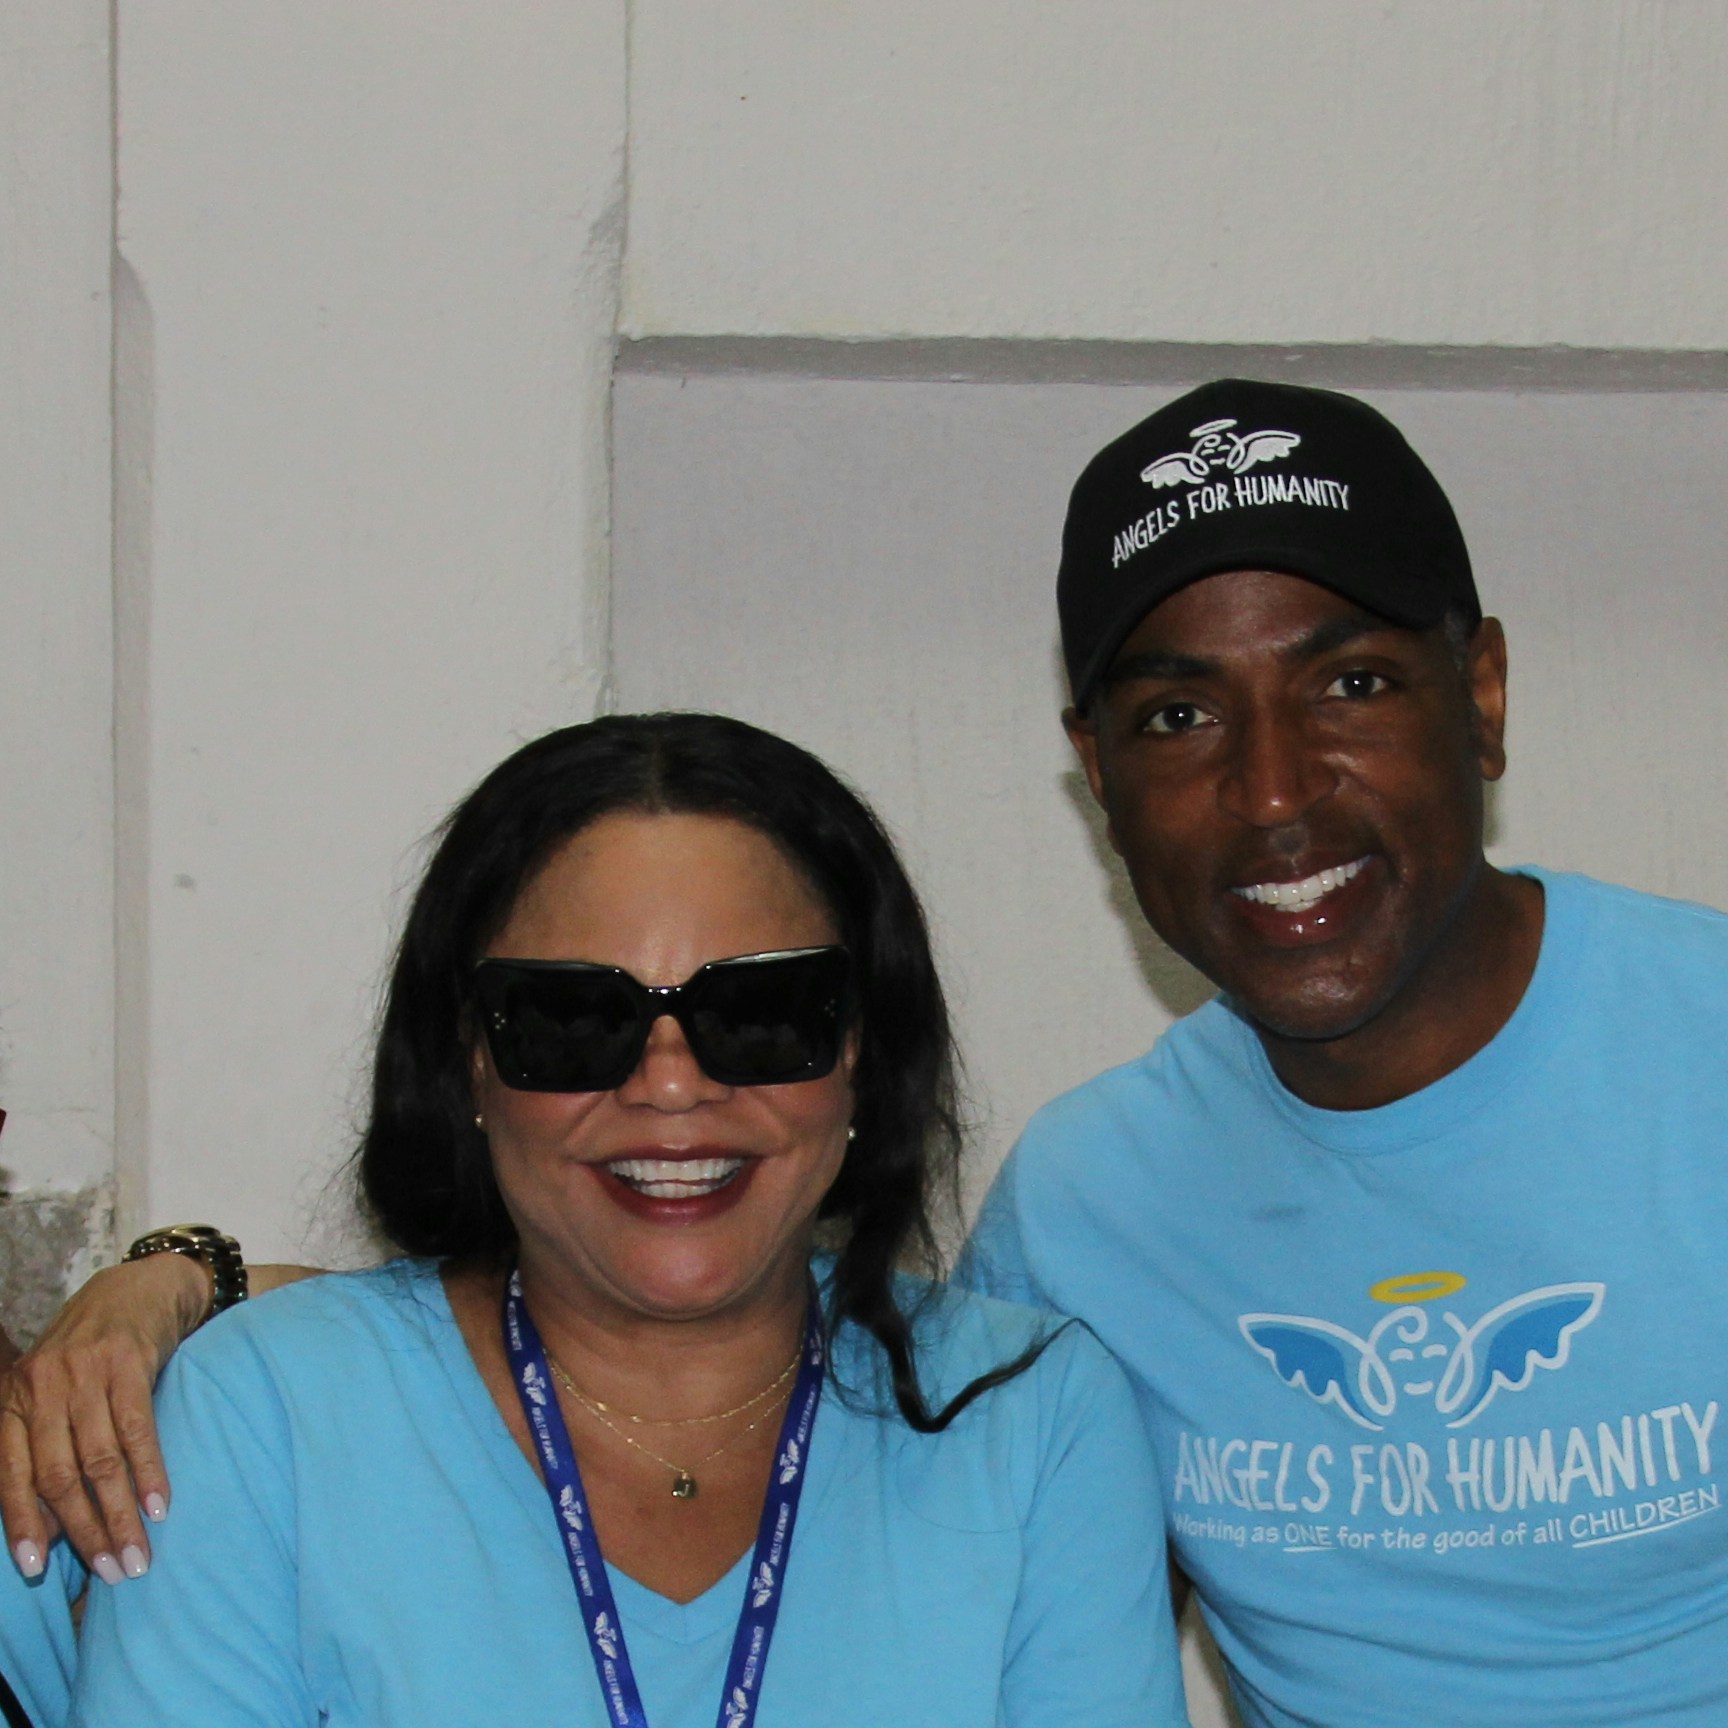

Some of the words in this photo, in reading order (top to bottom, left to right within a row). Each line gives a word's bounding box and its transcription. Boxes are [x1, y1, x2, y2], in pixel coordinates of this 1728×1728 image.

[1111, 500, 1180, 568] ANGELS
[1187, 482, 1230, 520] FOR
[1233, 473, 1350, 512] HUMANITY
[1174, 1431, 1334, 1514] ANGELS
[1350, 1438, 1439, 1517] FOR
[1446, 1400, 1718, 1514] HUMANITY
[1171, 1510, 1246, 1548] Working
[1251, 1524, 1279, 1545] as
[1283, 1521, 1333, 1548] ONE
[1336, 1523, 1376, 1549] for
[1381, 1521, 1426, 1549] the
[1433, 1520, 1495, 1554] good
[1500, 1520, 1528, 1548] of
[1533, 1517, 1563, 1544] all
[1568, 1483, 1720, 1540] CHILDREN
